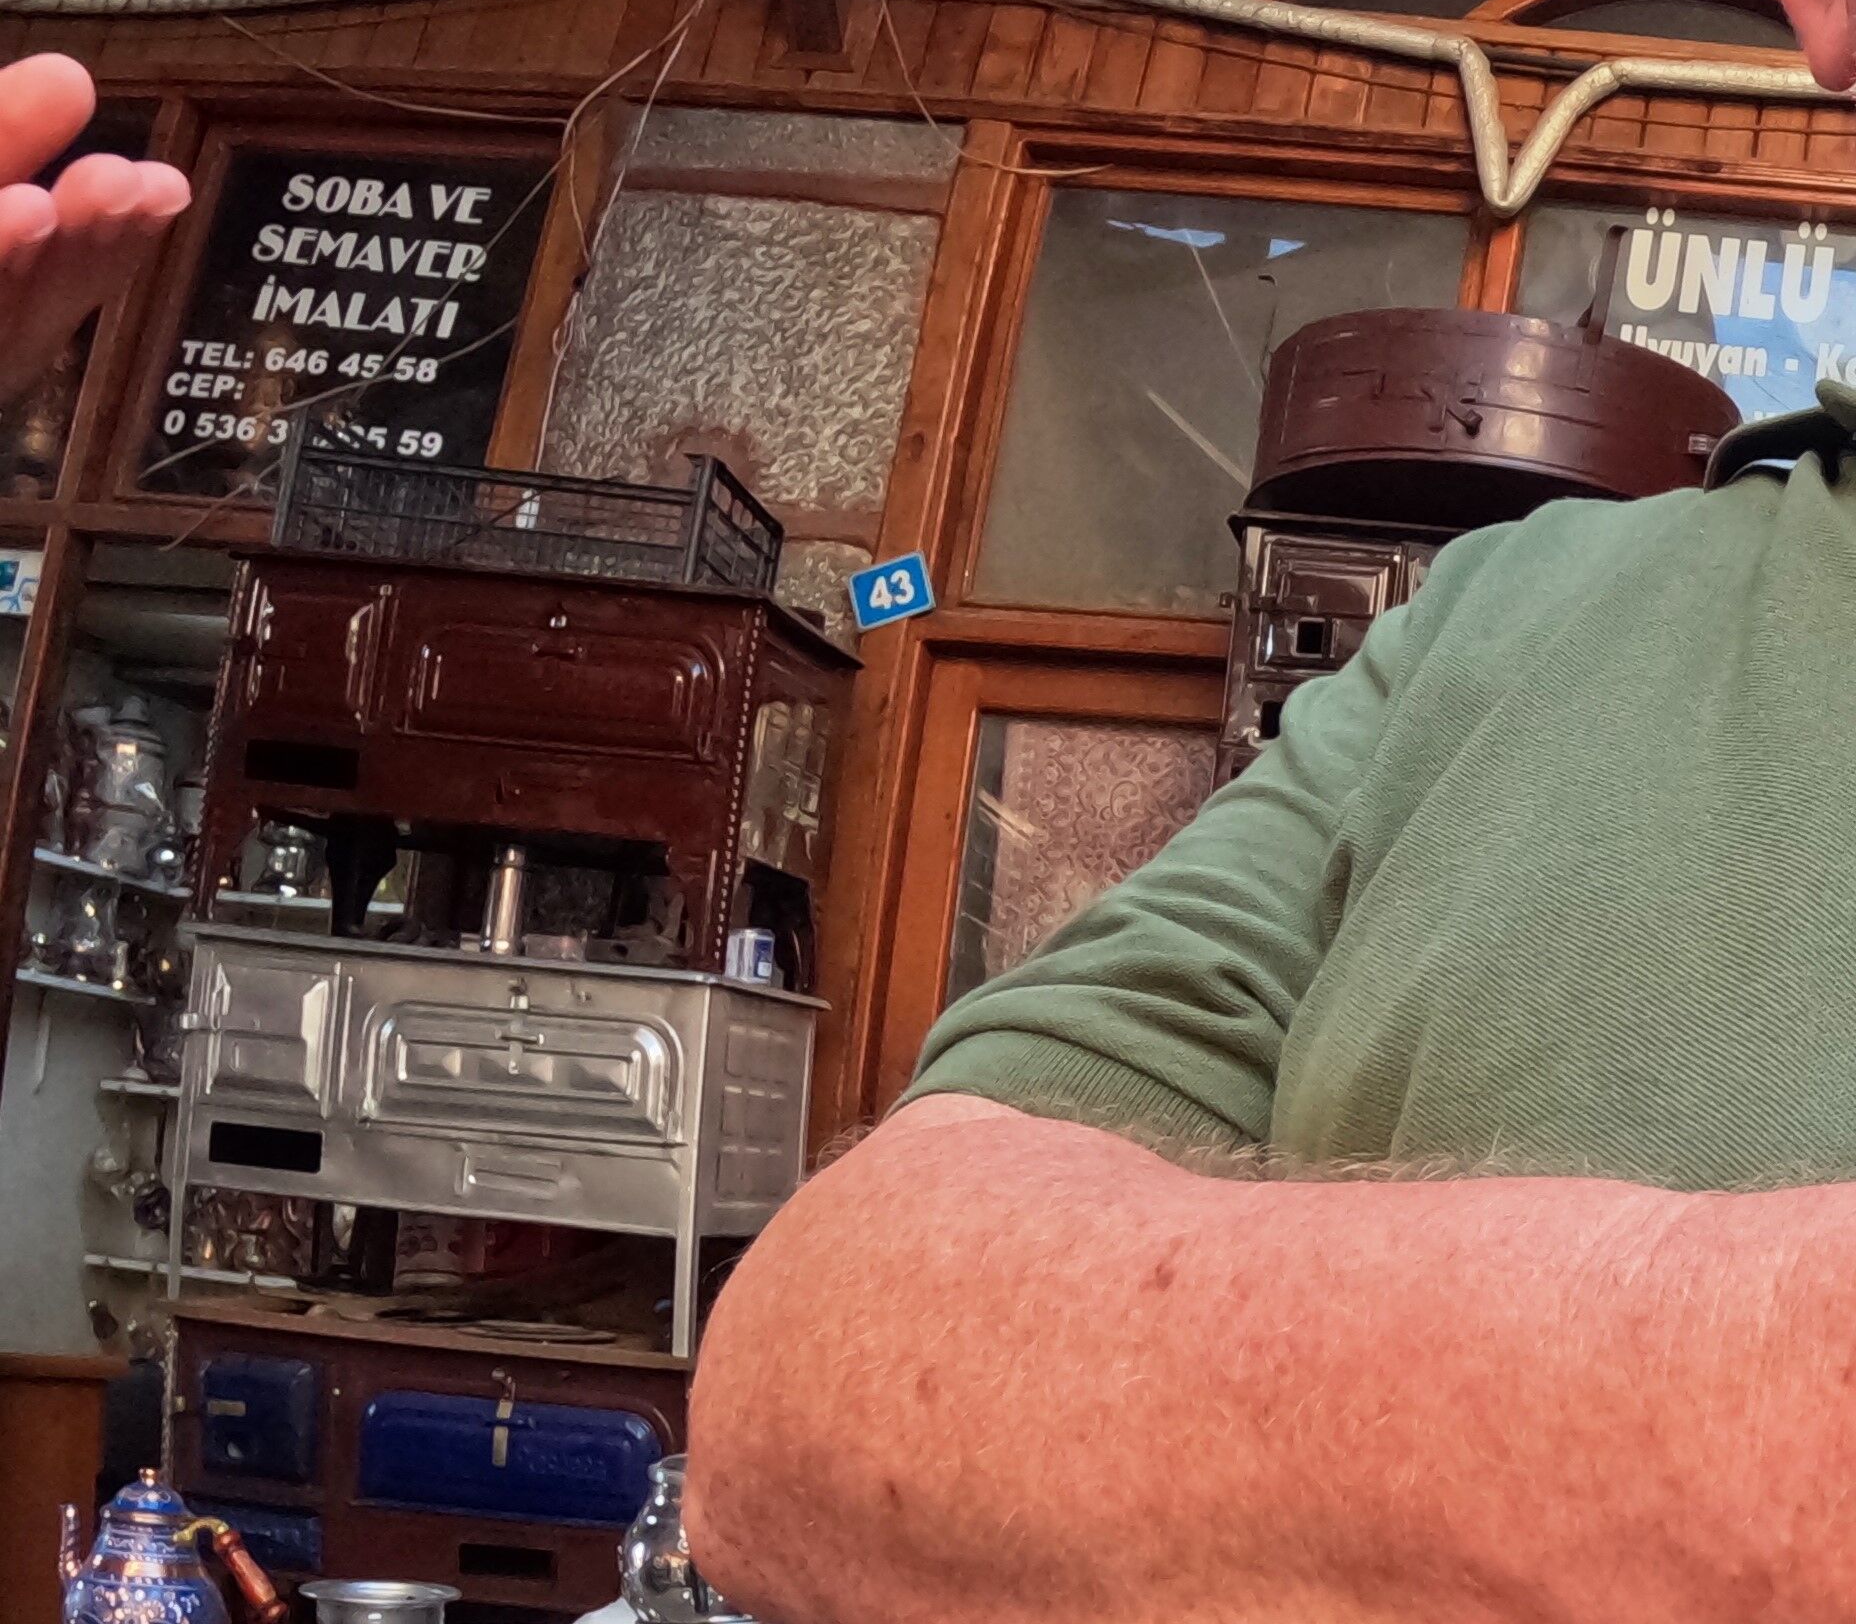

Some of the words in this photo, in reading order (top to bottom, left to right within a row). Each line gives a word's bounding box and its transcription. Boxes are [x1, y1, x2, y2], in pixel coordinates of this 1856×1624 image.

[282, 174, 413, 219] SOBA
[430, 184, 492, 224] VE
[252, 224, 487, 282] SEMAVER
[1626, 206, 1835, 325] ÜNLÜ
[252, 274, 460, 339] İMALATI
[166, 372, 245, 400] CEP:
[181, 341, 252, 368] TEL:
[264, 347, 330, 375] 646
[338, 353, 384, 378] 45
[393, 356, 438, 383] 58
[164, 410, 186, 435] 0
[193, 413, 256, 442] 536
[397, 429, 443, 458] 59
[869, 569, 915, 610] 43
